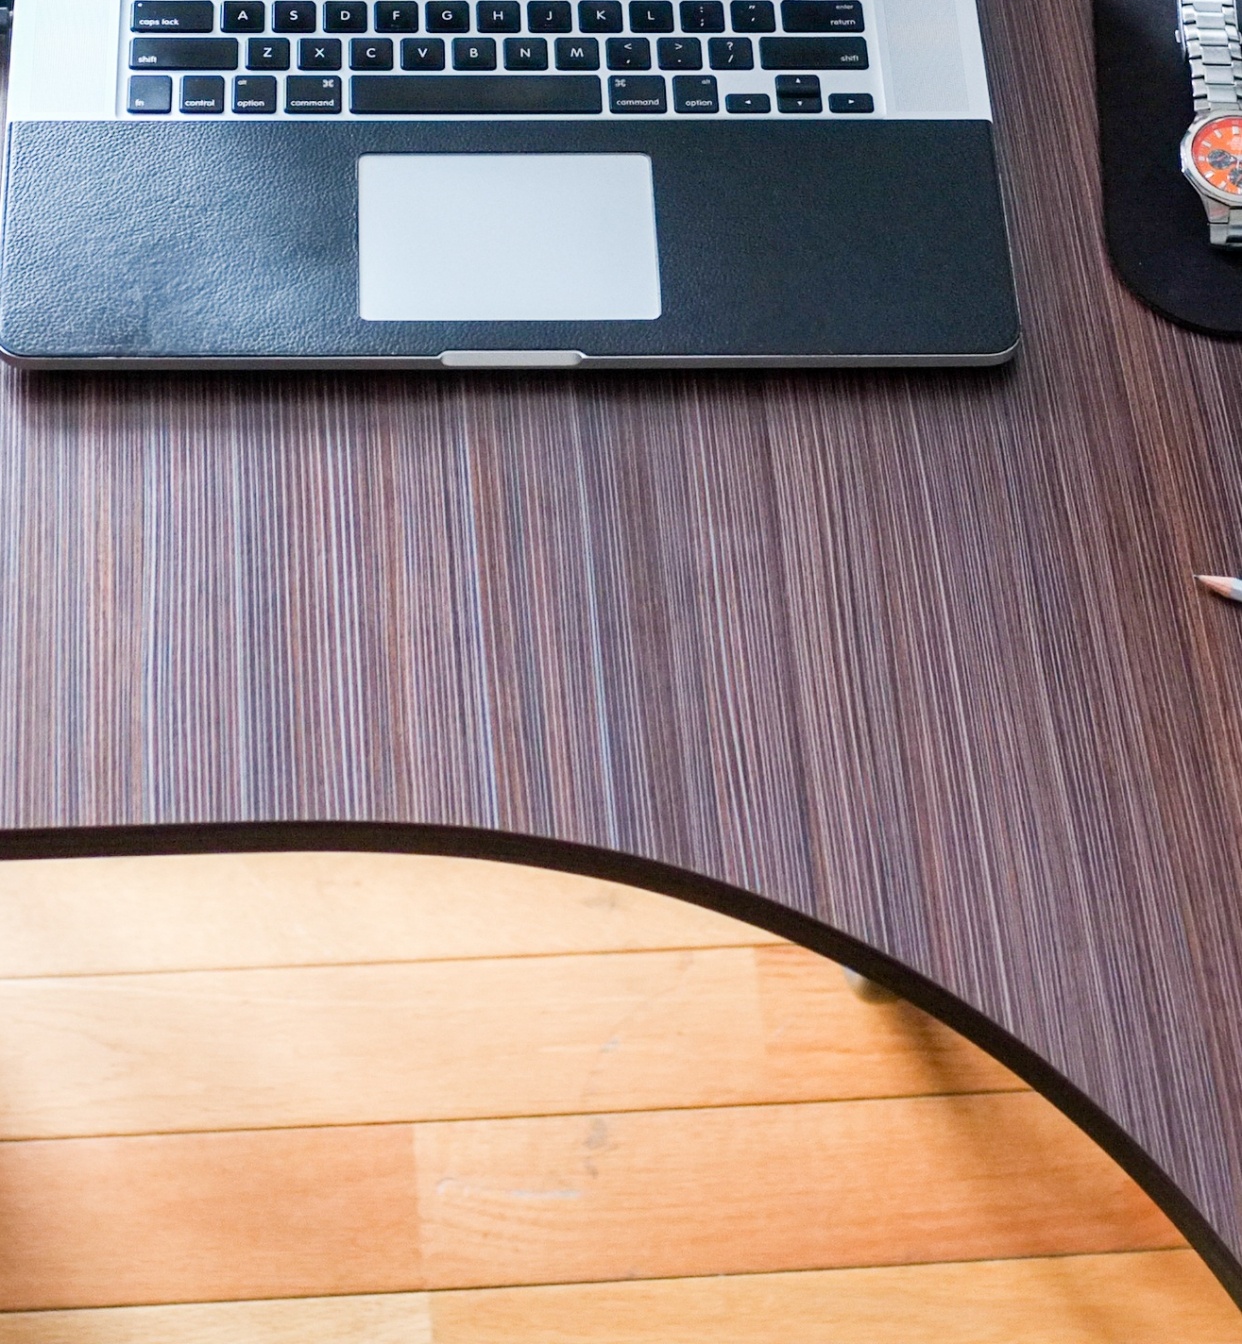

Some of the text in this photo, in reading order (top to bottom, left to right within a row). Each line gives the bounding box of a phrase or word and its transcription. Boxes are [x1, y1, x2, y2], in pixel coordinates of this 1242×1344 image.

[238, 11, 248, 20] A
[290, 10, 298, 20] S
[341, 11, 350, 20] D
[393, 11, 399, 20] F
[442, 11, 452, 20] G
[493, 11, 503, 20] H
[547, 11, 552, 20] J
[597, 11, 606, 19] K
[648, 11, 654, 20] L
[263, 48, 272, 57] Z
[315, 48, 324, 57] X
[366, 48, 375, 58] C
[418, 48, 427, 57] V
[470, 48, 478, 57] B
[520, 48, 530, 57] N
[571, 48, 583, 57] M
